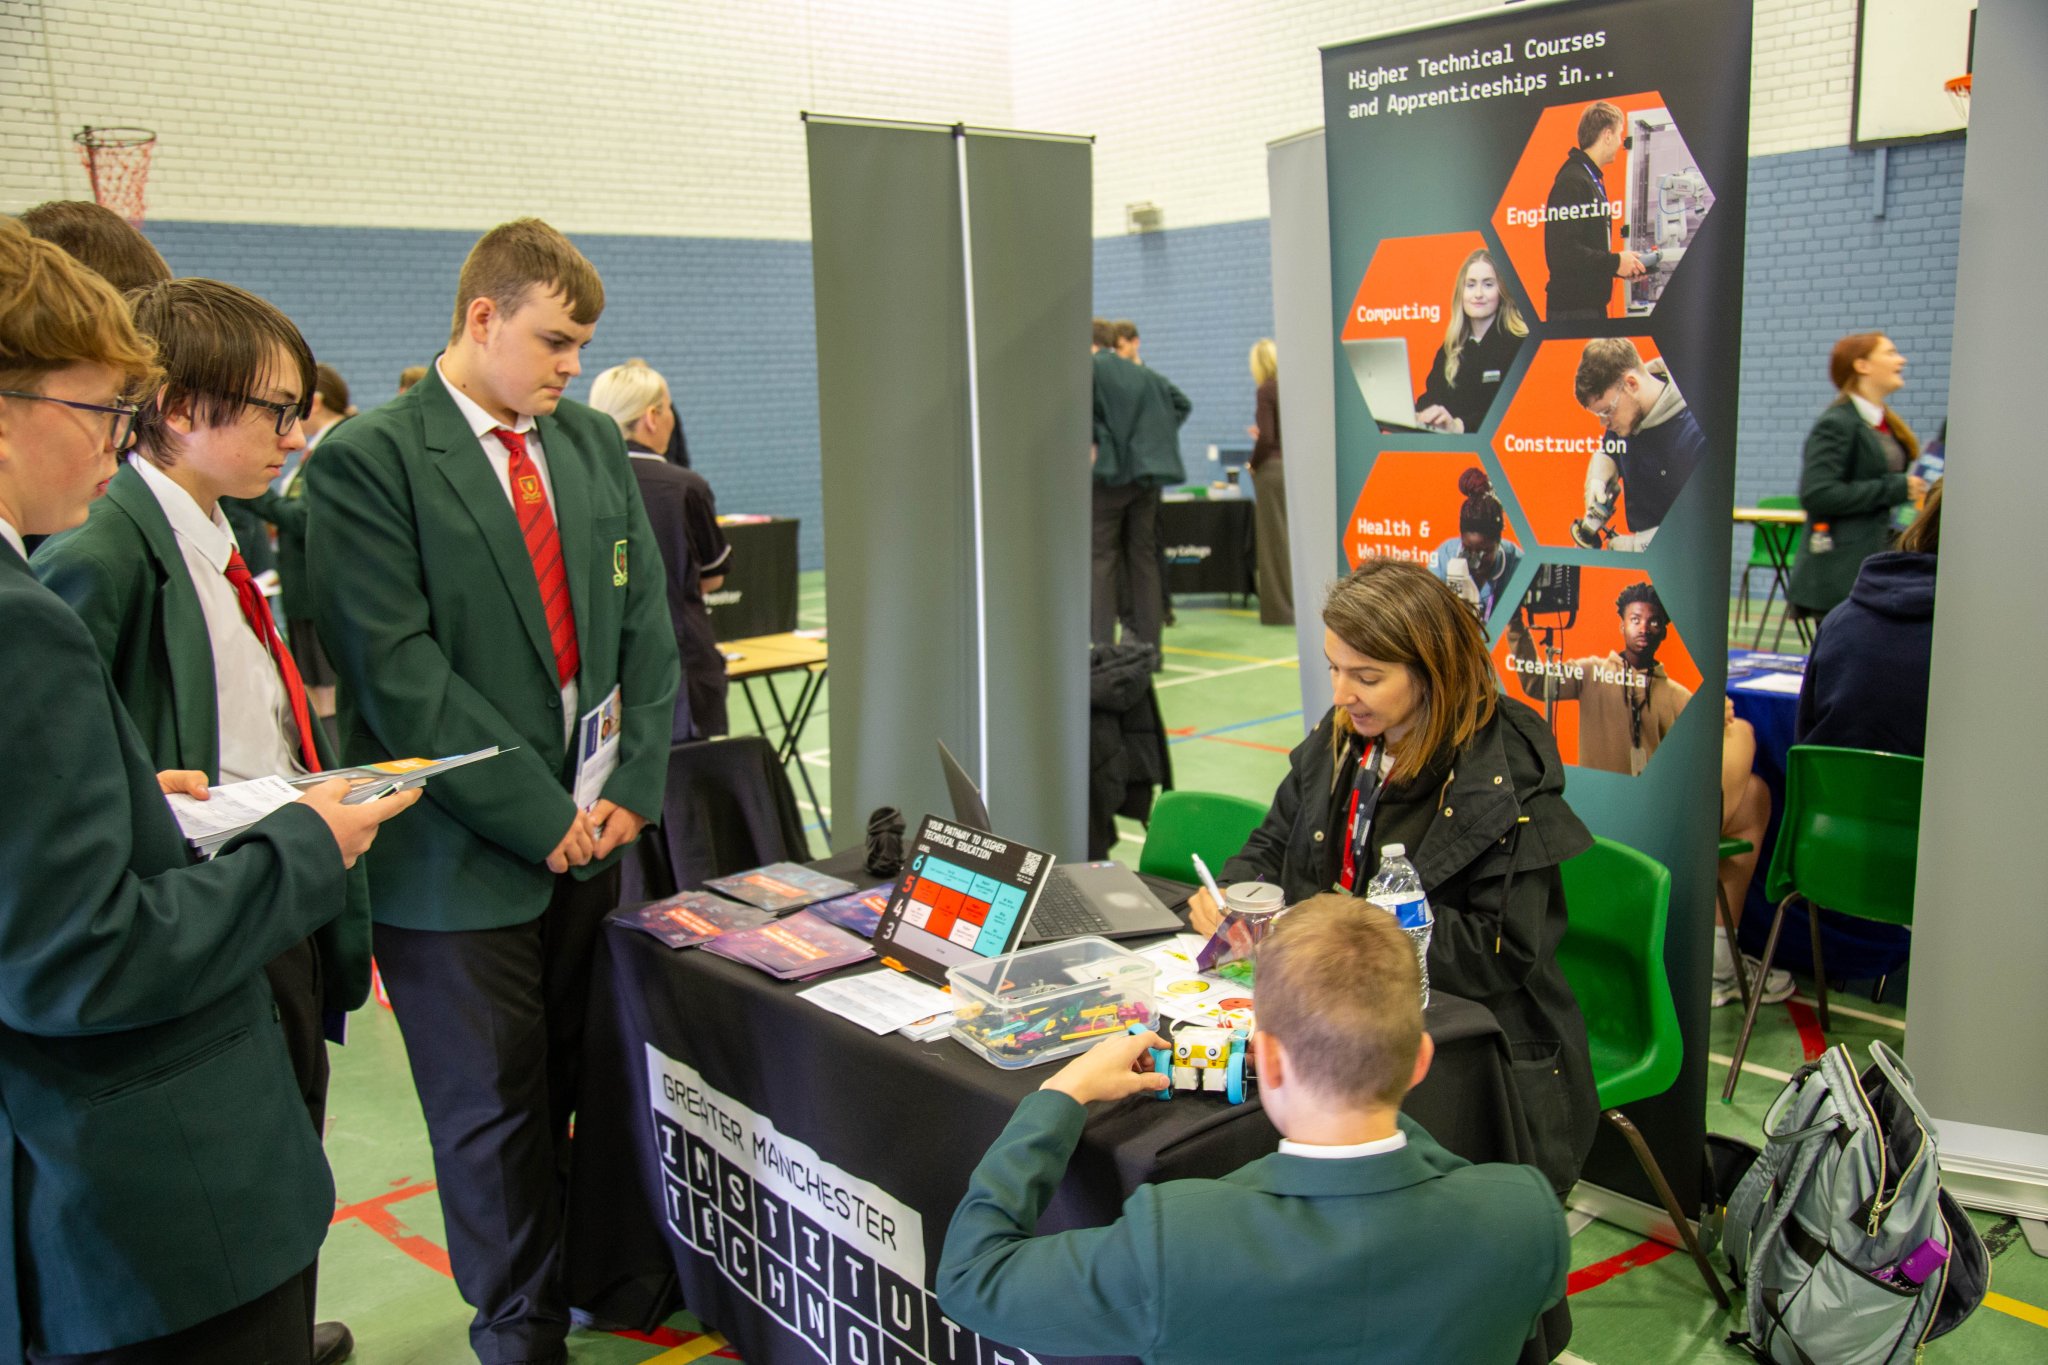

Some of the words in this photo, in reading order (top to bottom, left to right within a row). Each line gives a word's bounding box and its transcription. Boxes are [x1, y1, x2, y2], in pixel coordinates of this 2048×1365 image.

[1348, 65, 1408, 91] Higher
[1418, 44, 1514, 78] Technical
[1525, 30, 1606, 60] Courses
[1348, 99, 1378, 119] and
[1387, 74, 1547, 114] Apprenticeships
[1559, 64, 1615, 86] in...
[1507, 199, 1622, 227] Engineering
[1357, 302, 1440, 324] Computing
[1504, 434, 1627, 454] Construction
[1357, 518, 1411, 537] Health
[1419, 521, 1430, 538] &
[1357, 543, 1439, 567] Wellbeing
[1505, 655, 1584, 682] Creative
[1593, 667, 1647, 688] Media
[924, 830, 954, 848] TECHNICAL
[957, 842, 992, 860] EDUCATION
[928, 820, 944, 833] YOUR
[944, 825, 971, 841] PATHWAY
[971, 834, 982, 844] TO
[982, 838, 1007, 853] HIGHER
[913, 855, 924, 871] 6
[903, 876, 915, 893] 5
[893, 899, 904, 917] 4
[883, 923, 895, 939] 3
[663, 1073, 744, 1151] GREATER
[752, 1131, 897, 1251] MANCHESTER
[668, 1185, 900, 1365] TECHNO
